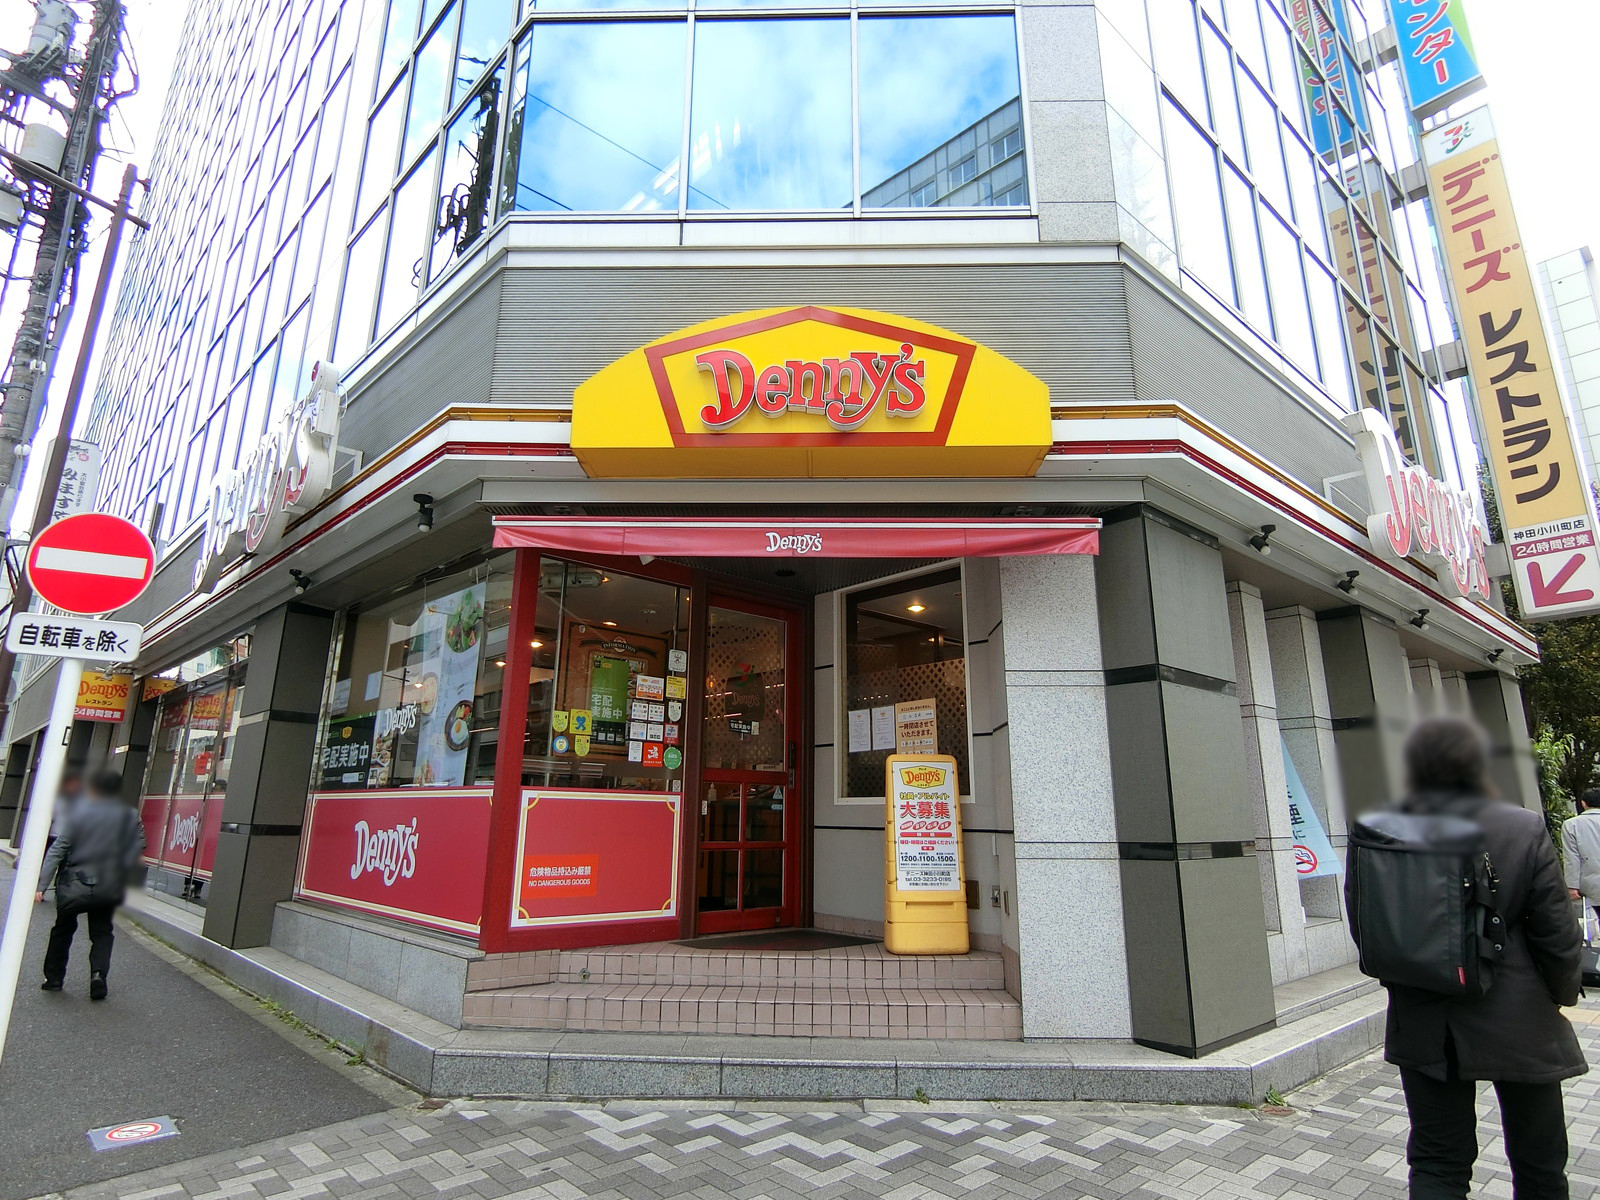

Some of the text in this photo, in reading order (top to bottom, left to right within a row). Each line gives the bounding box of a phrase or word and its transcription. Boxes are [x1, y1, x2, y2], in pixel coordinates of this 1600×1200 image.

[1398, 0, 1452, 85] ンター
[1442, 152, 1520, 294] デニーズ
[695, 343, 926, 432] Denny's
[1478, 307, 1561, 505] レストラン
[1341, 407, 1491, 601] Denny's
[765, 531, 823, 554] Denny's
[1513, 519, 1585, 540] 神田小川町店
[1515, 533, 1590, 557] 24時間営業
[19, 622, 130, 654] 自転車を除く
[78, 680, 128, 699] Denny's
[591, 693, 613, 707] 宅配
[383, 700, 418, 737] Denny's
[591, 705, 623, 720] 実施中
[905, 769, 941, 784] Denny's
[900, 801, 950, 819] 大募集
[170, 811, 200, 853] Denny's
[350, 816, 419, 887] Denny's
[537, 878, 571, 886] DANGEROUS
